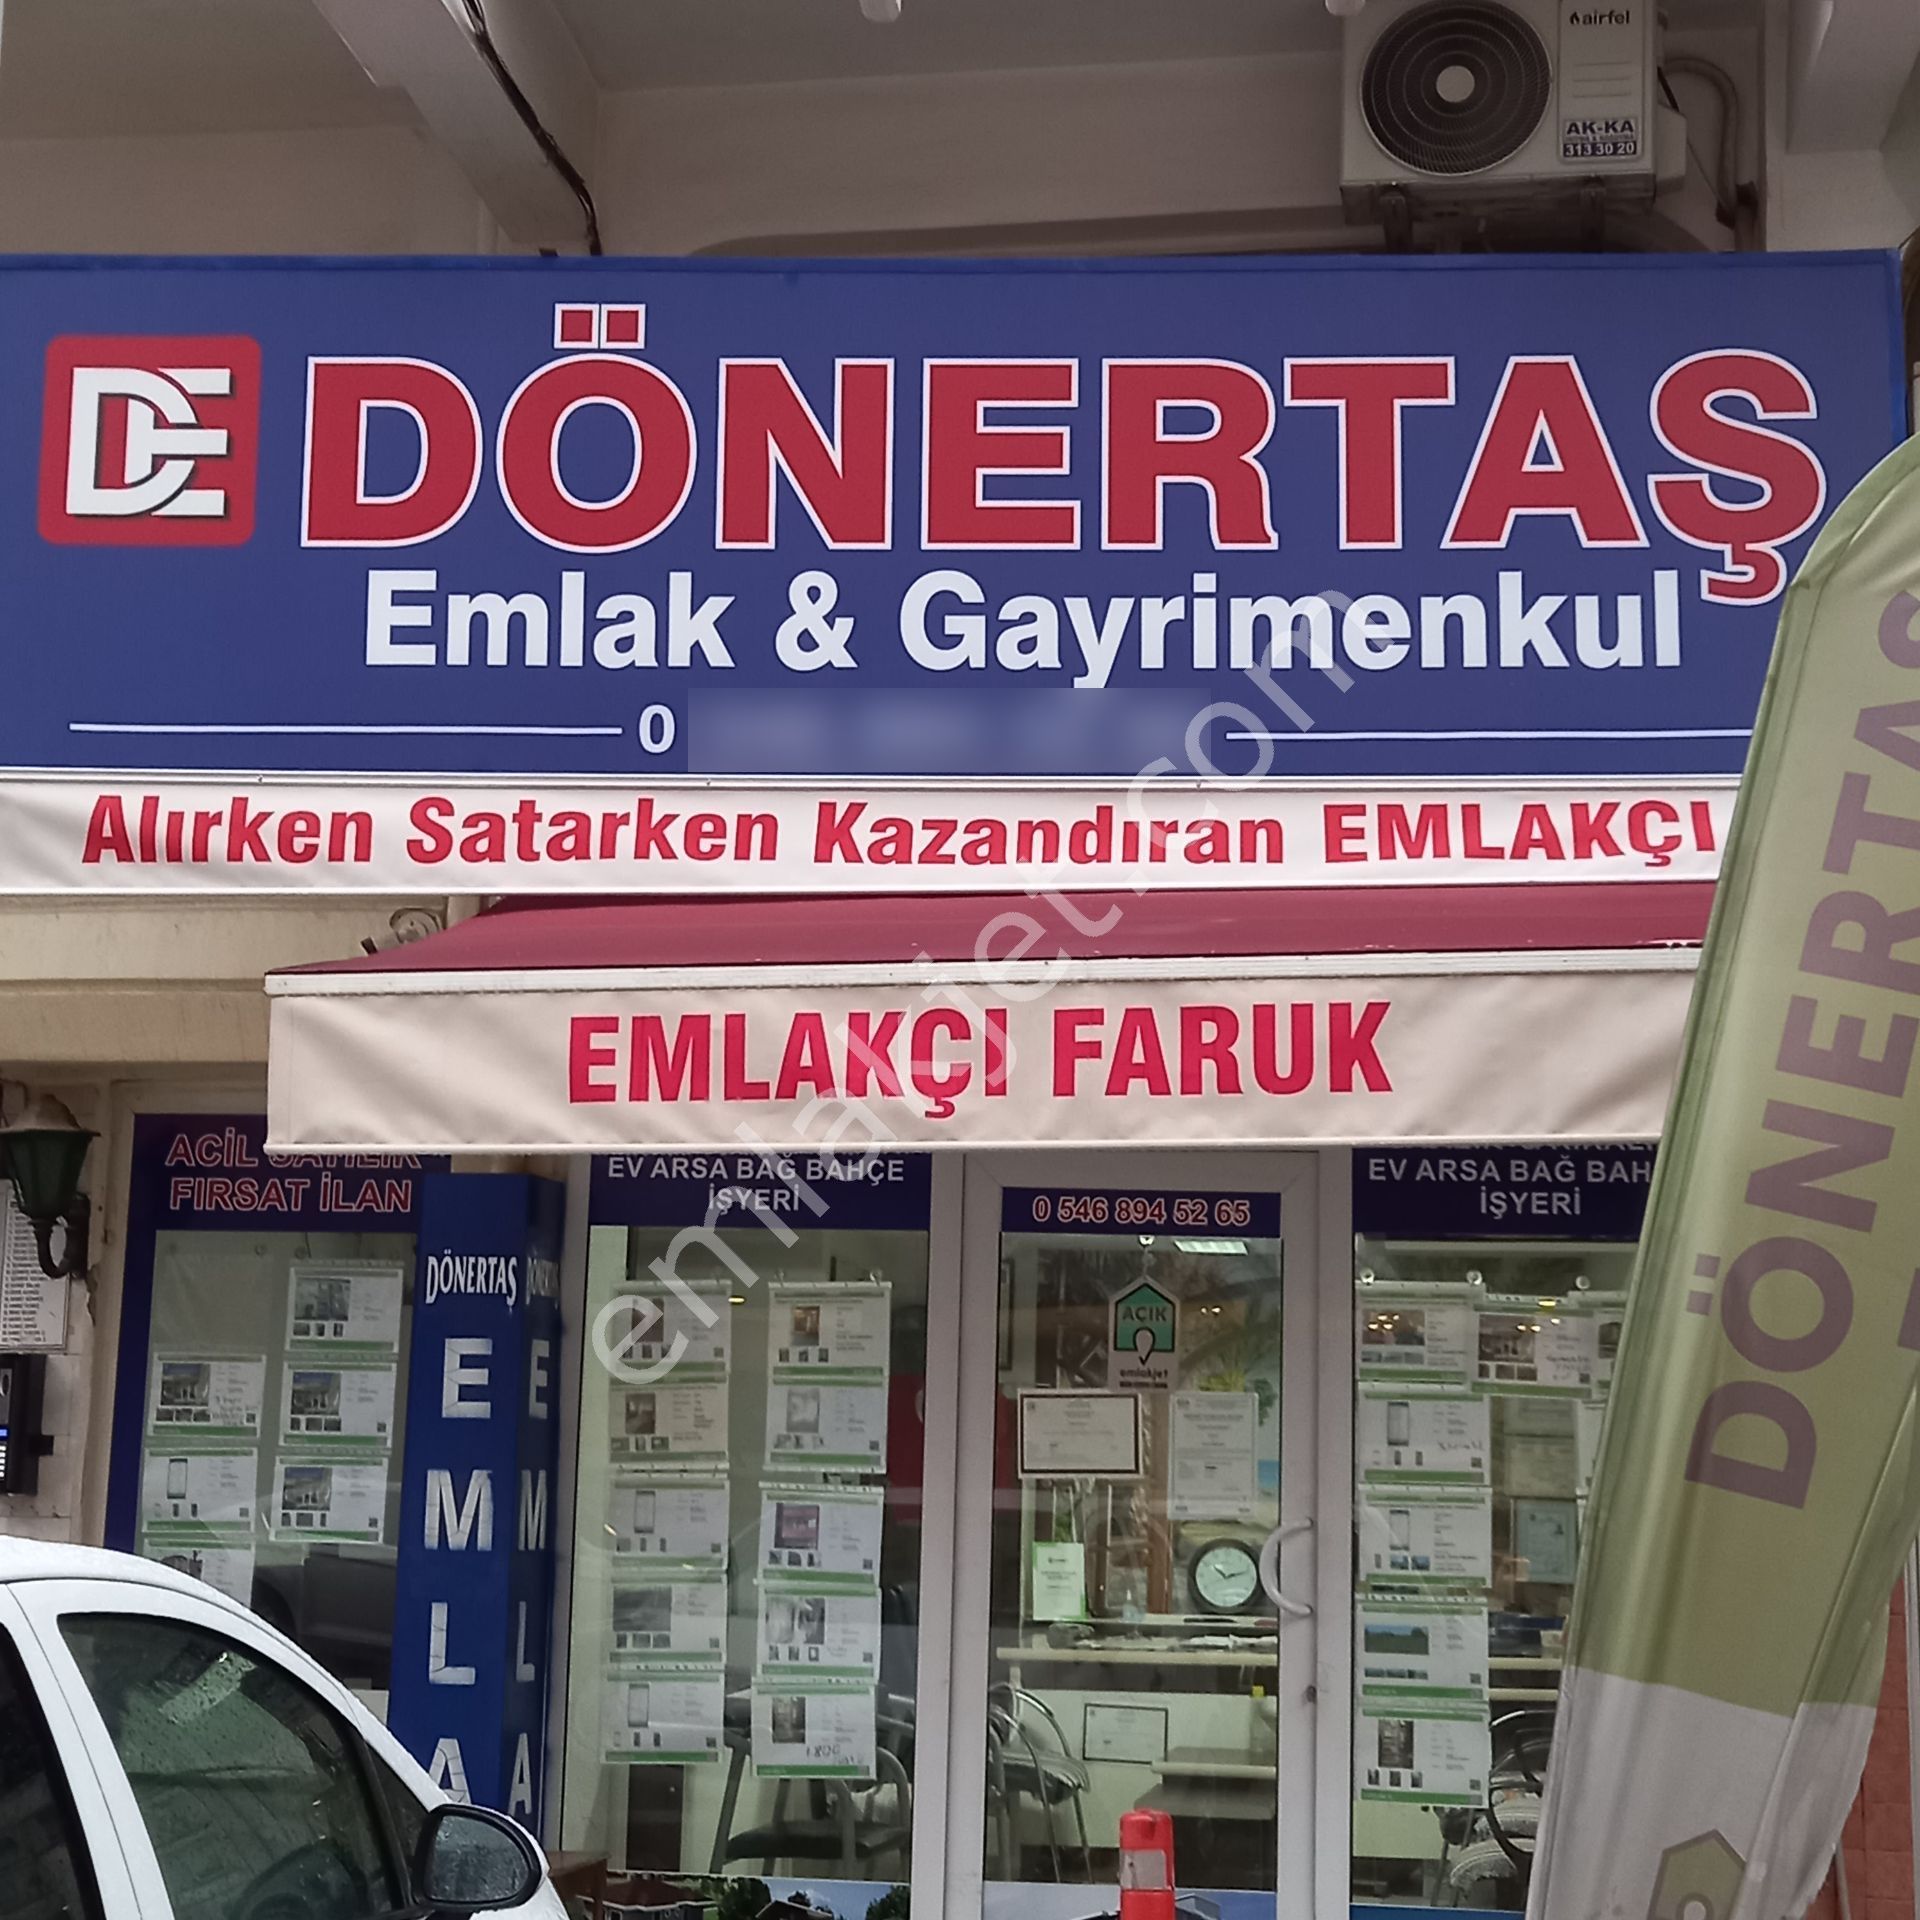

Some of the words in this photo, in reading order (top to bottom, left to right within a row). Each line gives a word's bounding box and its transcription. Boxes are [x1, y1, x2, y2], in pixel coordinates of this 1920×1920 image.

[1582, 9, 1631, 26] airfel
[1566, 119, 1635, 136] AK-KA
[1565, 142, 1593, 157] 313
[1595, 141, 1615, 155] 30
[1616, 141, 1635, 154] 20
[301, 302, 1827, 606] DÖNERTAŞ
[365, 569, 736, 667] Emlak
[775, 569, 858, 671] &
[899, 568, 1681, 688] Gayrimenkul
[638, 703, 676, 754] 0
[82, 794, 373, 864] Alırken
[406, 796, 778, 864] Satarken
[813, 800, 1284, 866] Kazandıran
[1323, 799, 1716, 867] EMLAKÇI
[568, 1007, 1008, 1119] EMLAKÇI
[1052, 1003, 1394, 1098] FARUK
[165, 1126, 258, 1168] ACİL
[608, 1156, 643, 1178] EV
[650, 1157, 728, 1180] ARSA
[736, 1152, 796, 1180] BAĞ
[806, 1158, 905, 1187] BAHÇE
[1369, 1158, 1407, 1181] EV
[1415, 1158, 1502, 1182] ARSA
[1510, 1154, 1576, 1183] BAĞ
[169, 1176, 311, 1212] FIRSAT
[319, 1171, 412, 1213] İLAN
[708, 1183, 800, 1215] İŞYERİ
[1033, 1195, 1051, 1222] 0
[1057, 1196, 1108, 1223] 546
[1115, 1196, 1167, 1224] 894
[1173, 1198, 1208, 1226] 52
[1214, 1199, 1250, 1227] 65
[1480, 1186, 1581, 1220] İŞYERİ
[425, 1248, 518, 1318] DÖNERTAŞ
